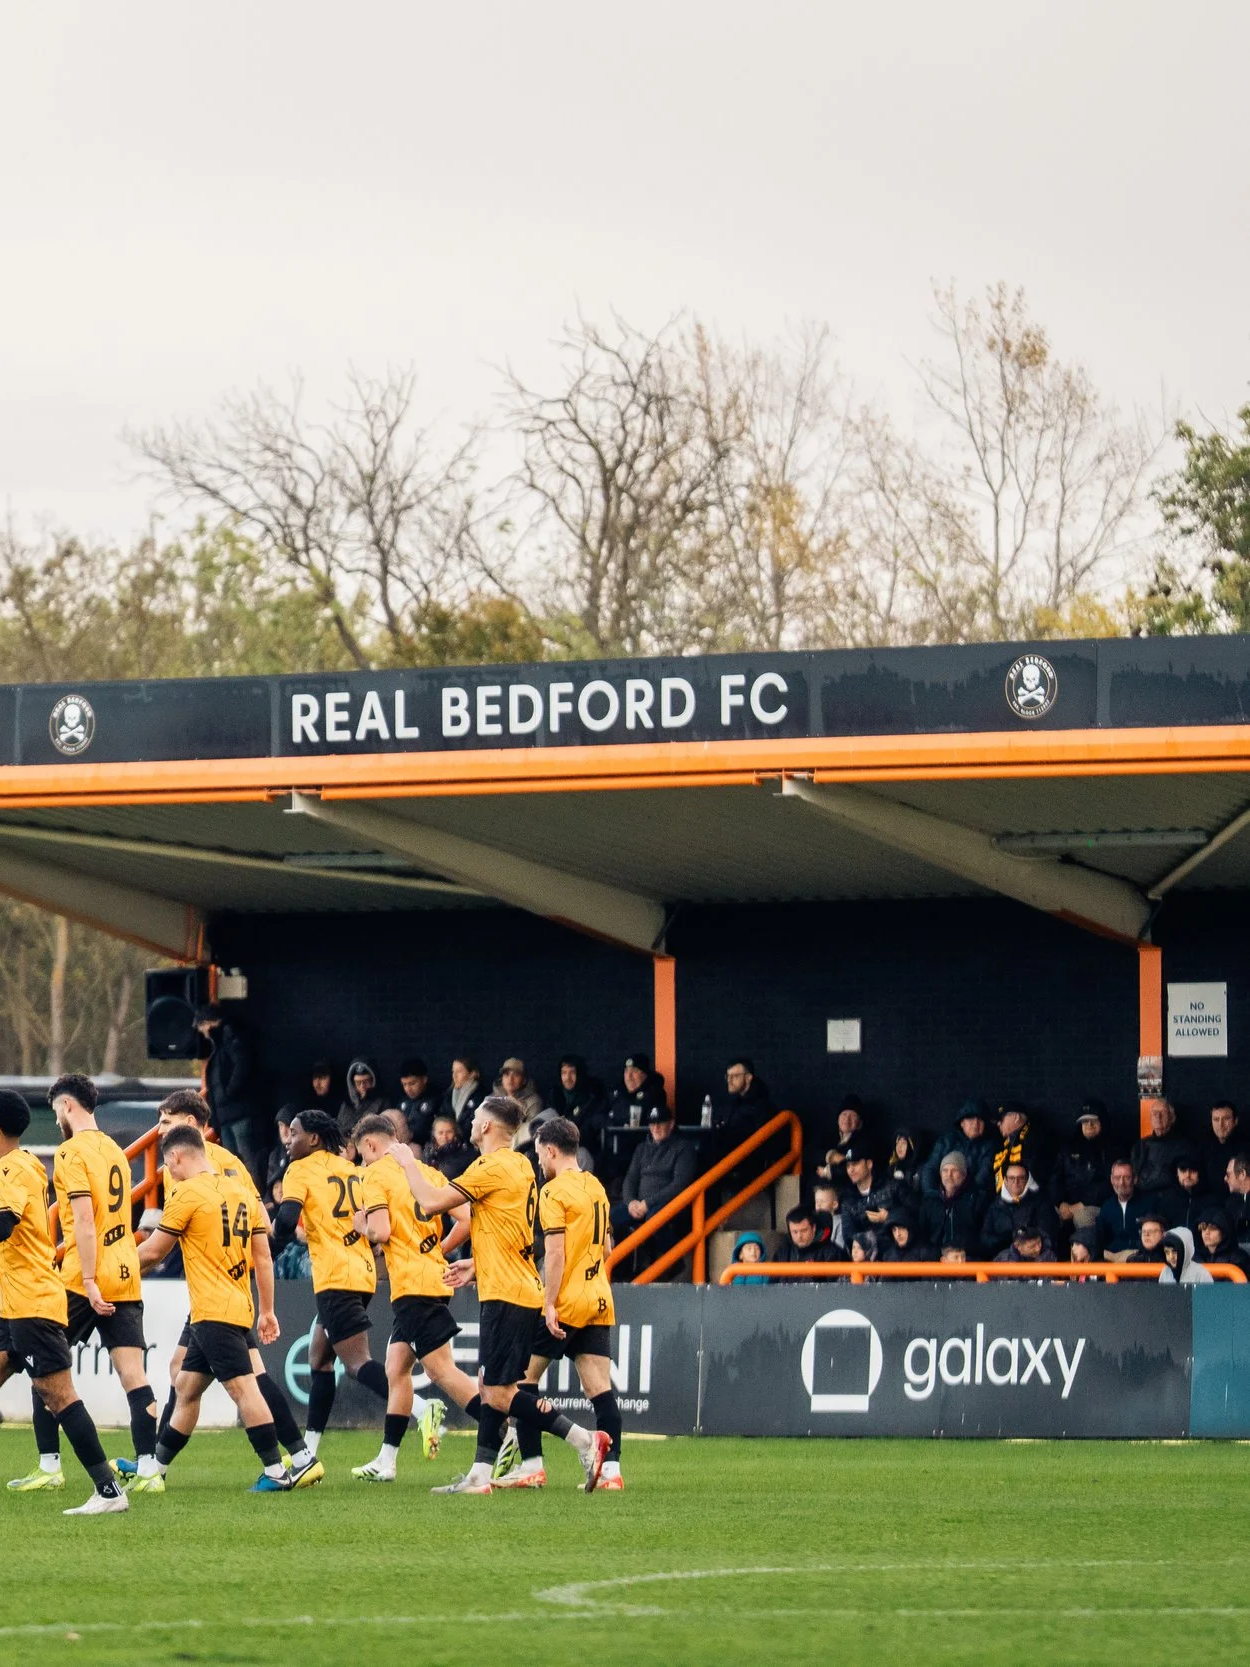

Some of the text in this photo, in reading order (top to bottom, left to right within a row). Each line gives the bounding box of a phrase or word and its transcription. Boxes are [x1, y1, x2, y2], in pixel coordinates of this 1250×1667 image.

[292, 672, 789, 743] REAL BEDFORD FC
[1173, 1014, 1222, 1024] STANDING
[1190, 1001, 1205, 1011] NO
[1175, 1027, 1220, 1037] ALLOWED
[108, 1164, 124, 1213] 9
[220, 1200, 250, 1249] 14
[903, 1323, 1086, 1400] galaxy
